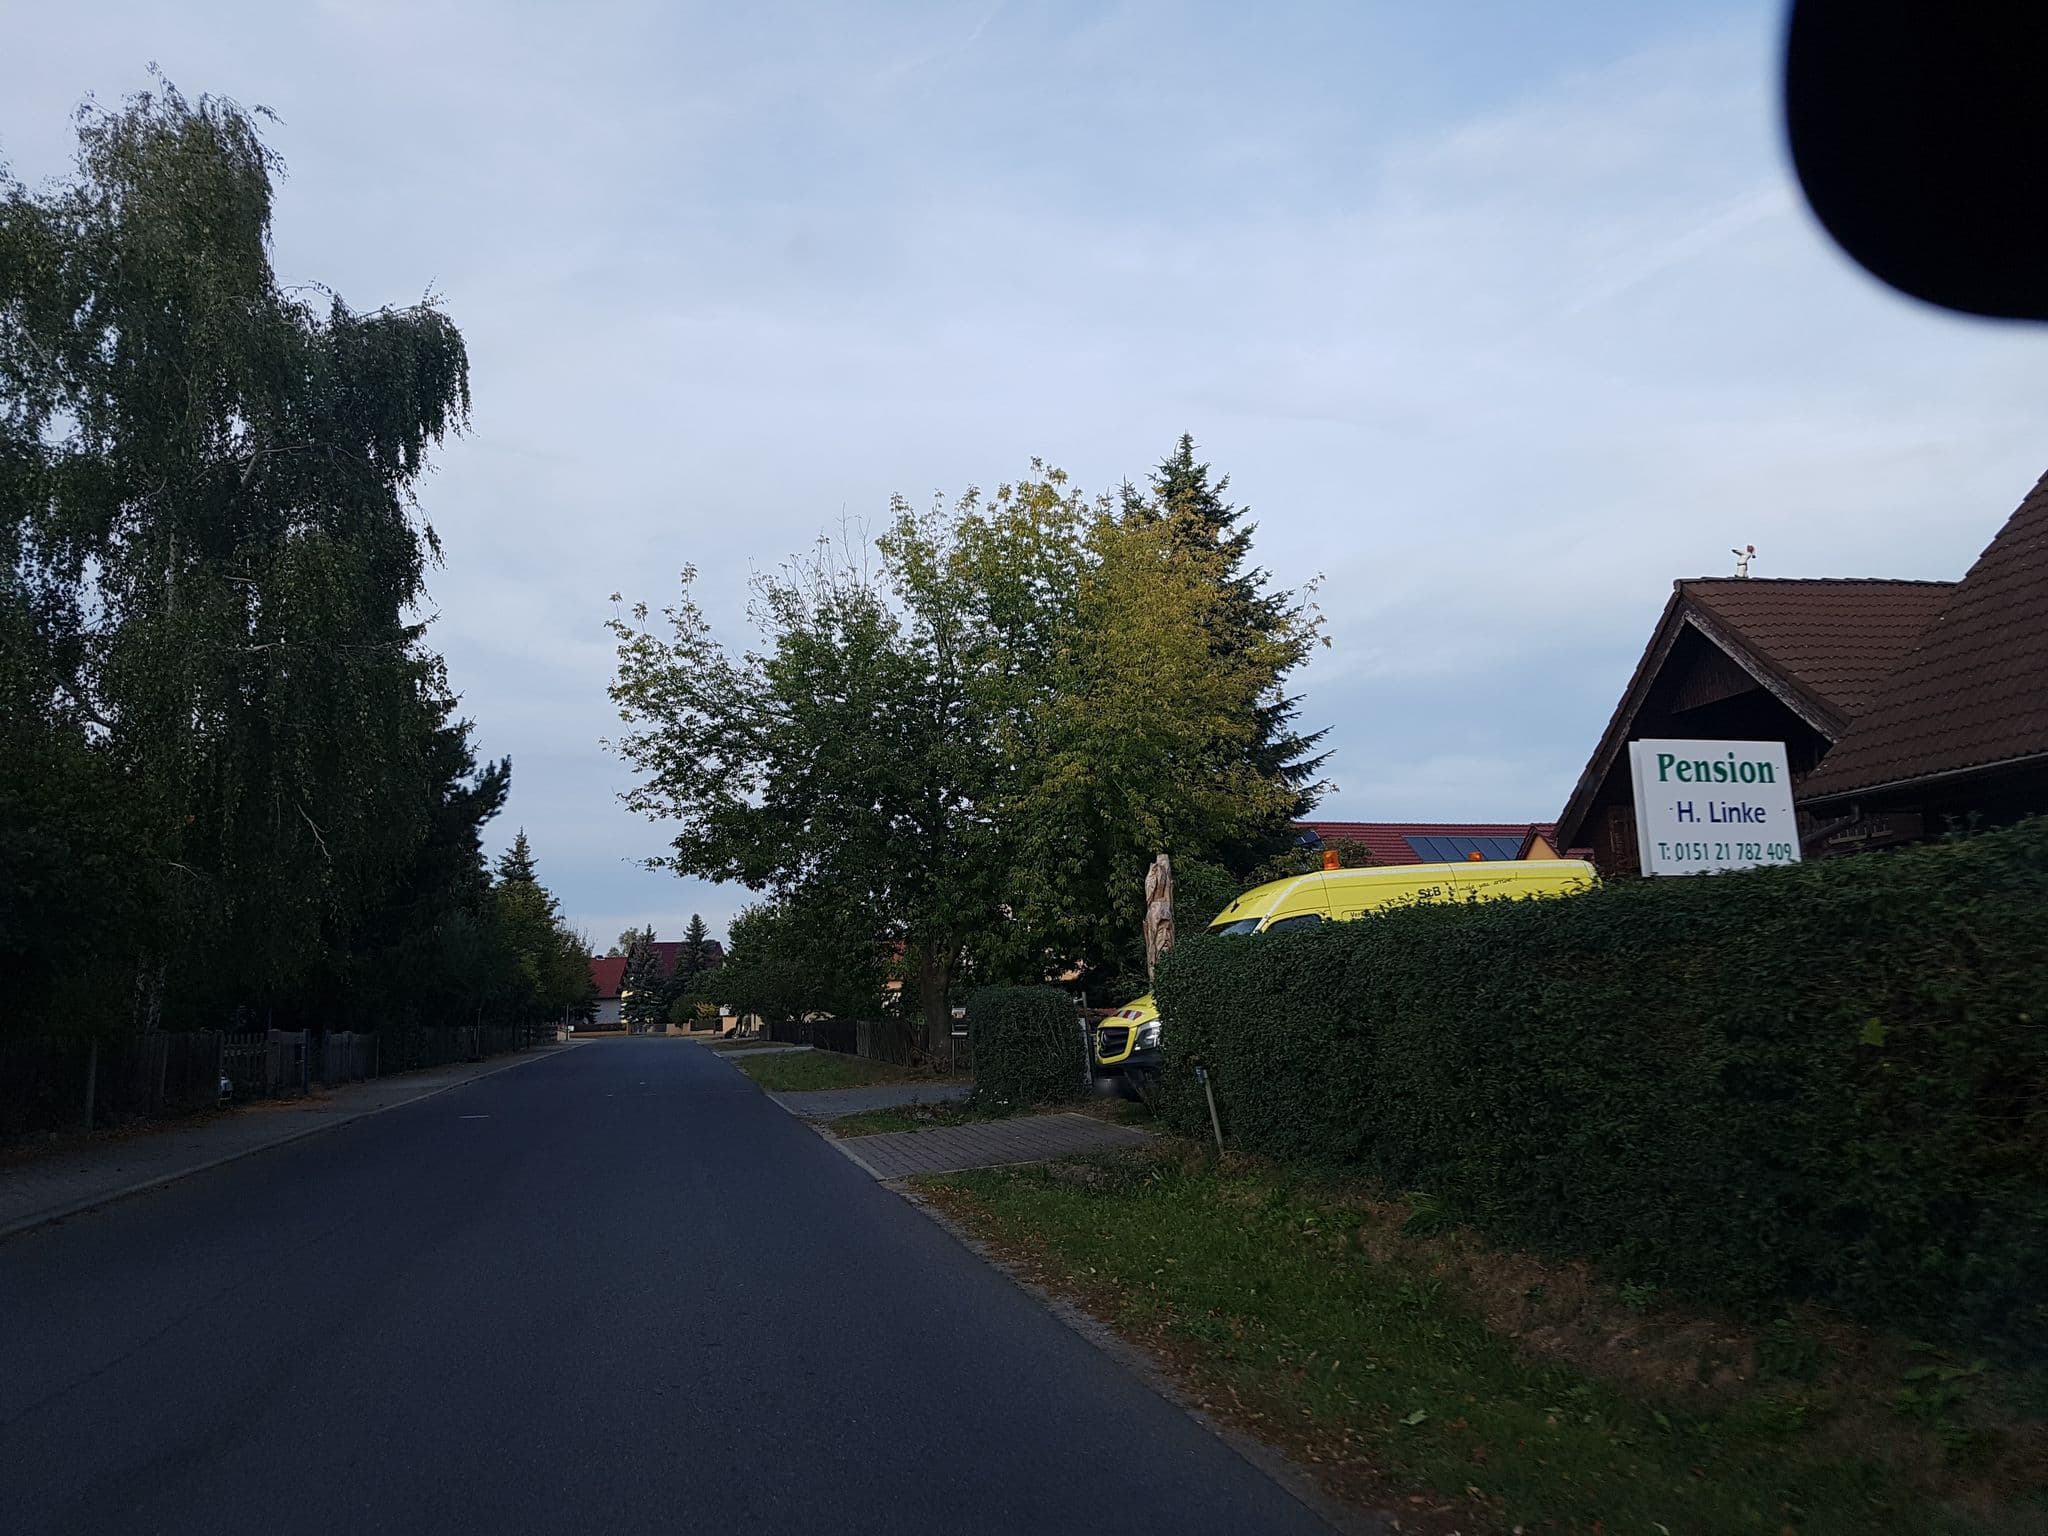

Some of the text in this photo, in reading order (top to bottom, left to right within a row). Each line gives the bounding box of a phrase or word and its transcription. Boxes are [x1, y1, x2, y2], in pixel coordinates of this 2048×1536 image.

[1656, 752, 1776, 784] Pension
[1677, 801, 1767, 823] H. Linke
[1675, 842, 1709, 861] 0151
[1714, 842, 1730, 860] 21
[1736, 842, 1762, 860] 782
[1767, 842, 1792, 861] 409
